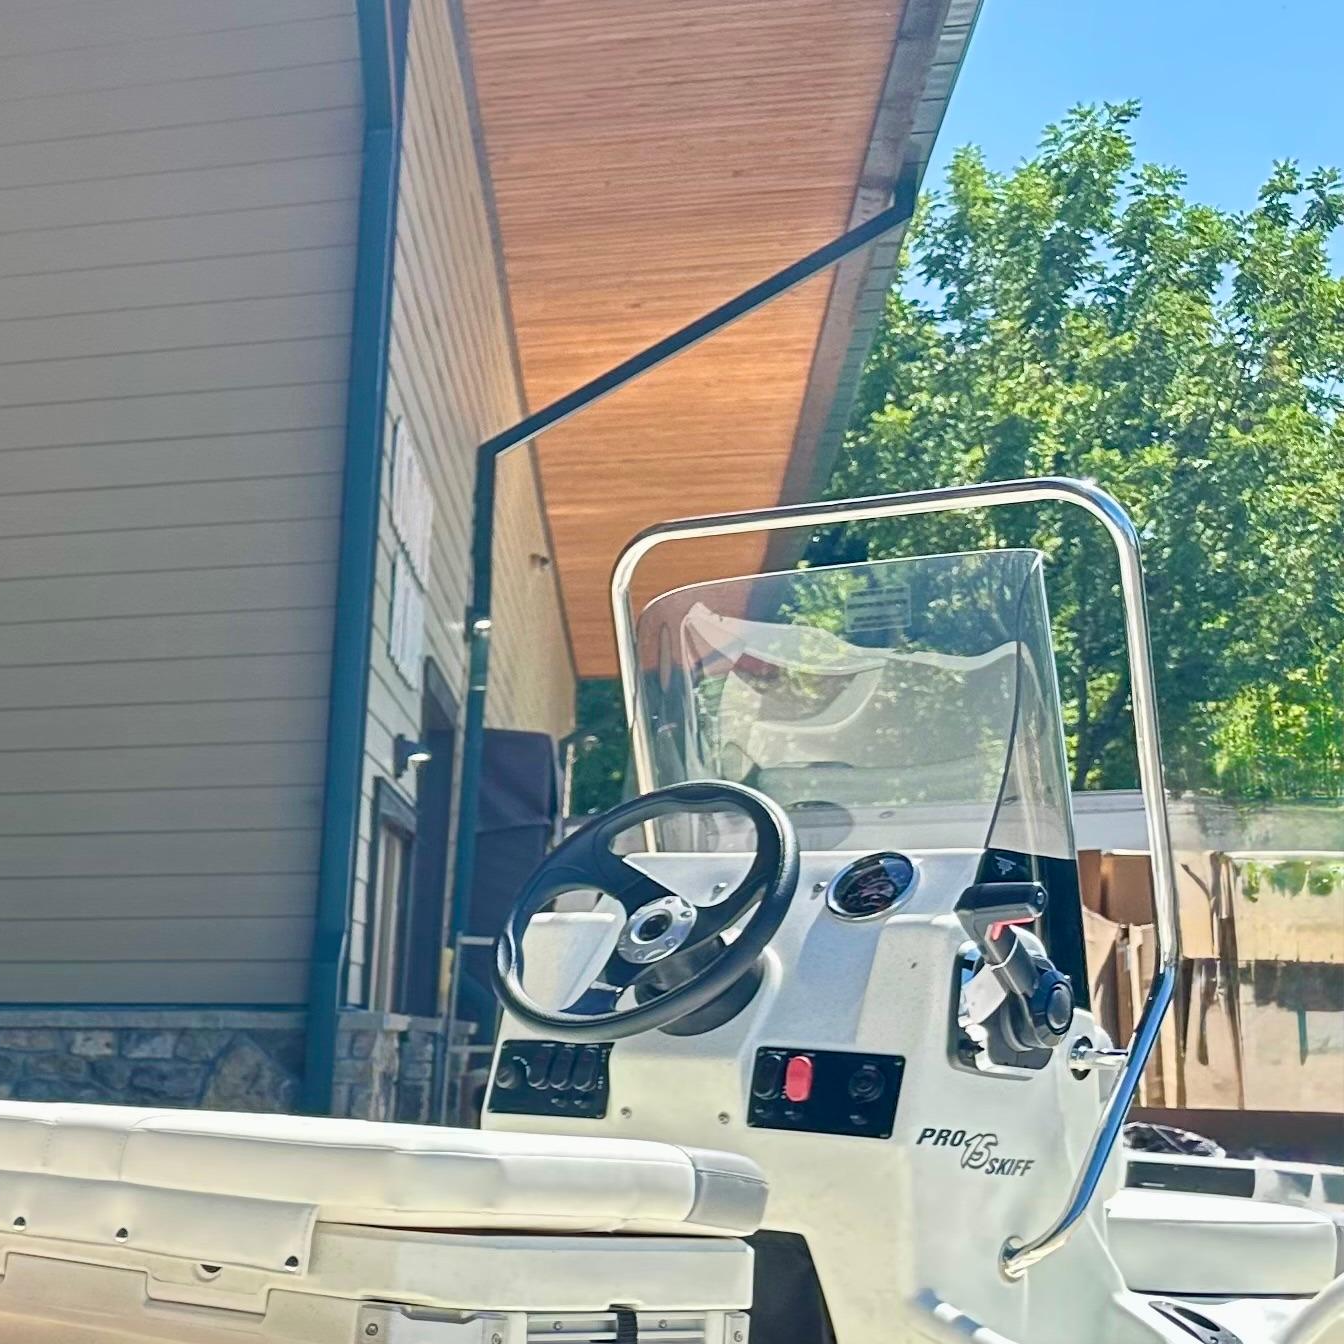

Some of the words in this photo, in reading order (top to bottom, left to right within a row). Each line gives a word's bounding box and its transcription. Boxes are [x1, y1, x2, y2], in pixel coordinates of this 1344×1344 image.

[916, 1128, 967, 1147] PRO
[960, 1133, 999, 1169] 15
[985, 1158, 1035, 1176] SKIFF
